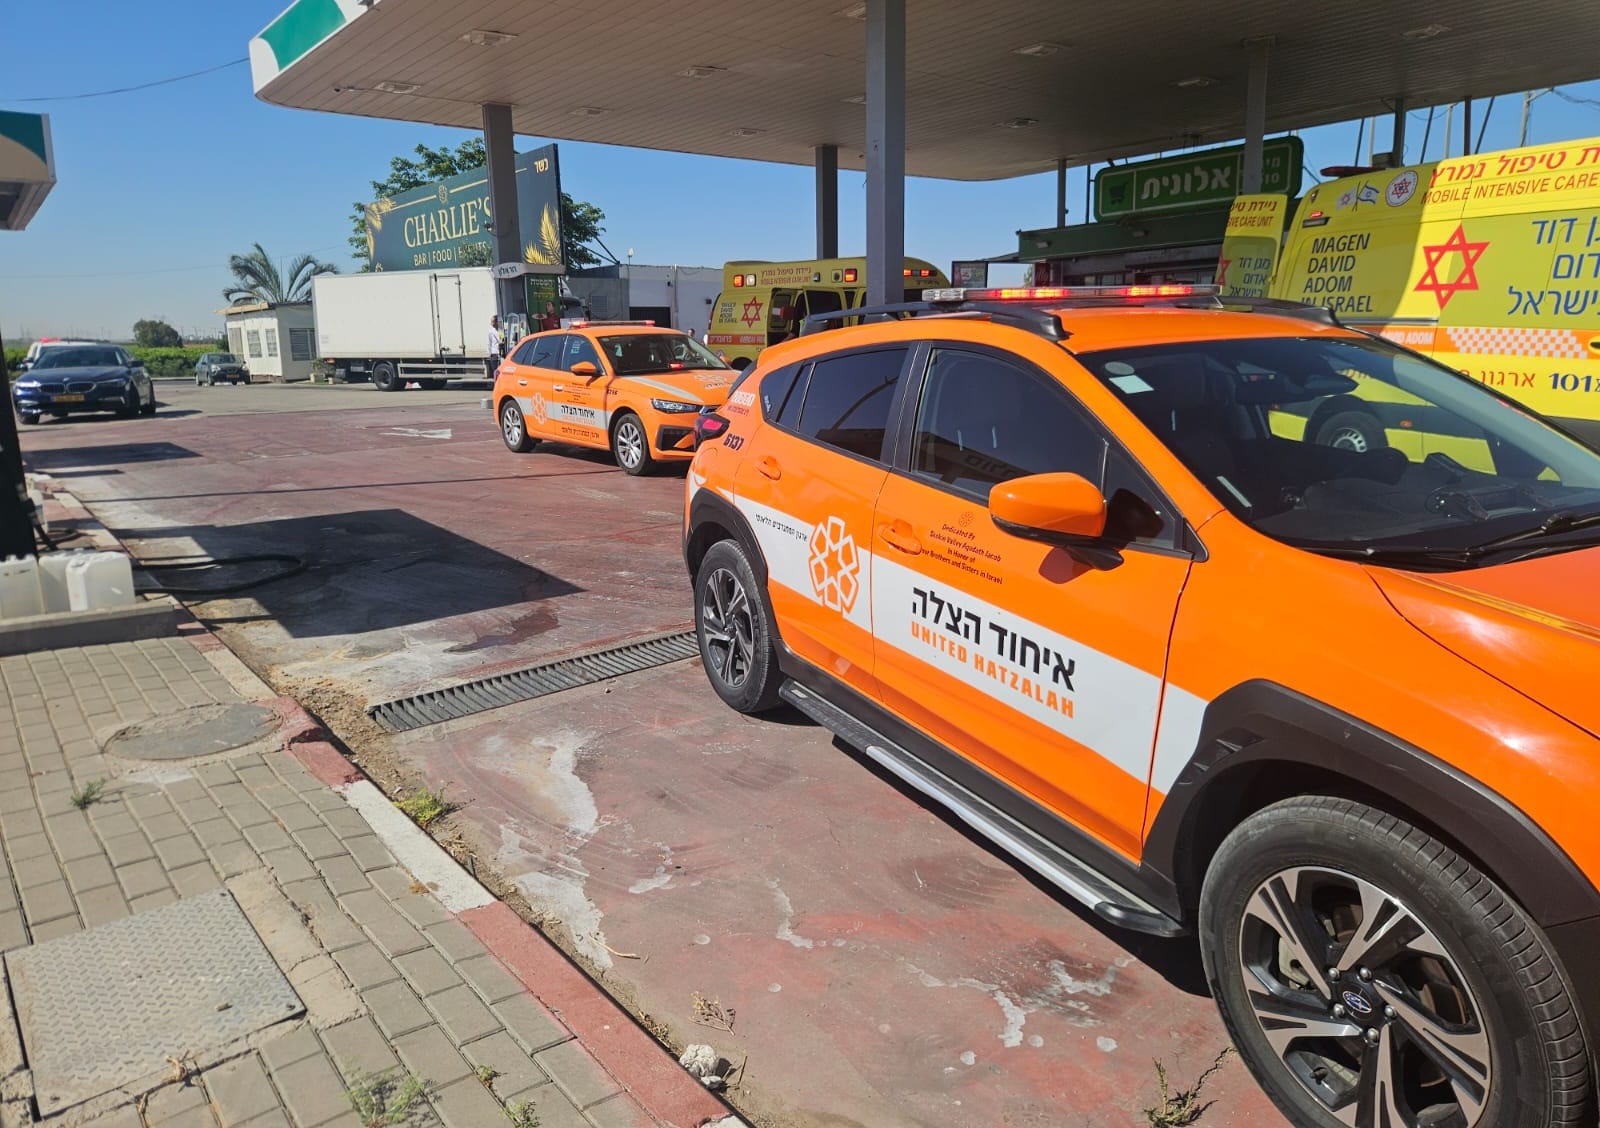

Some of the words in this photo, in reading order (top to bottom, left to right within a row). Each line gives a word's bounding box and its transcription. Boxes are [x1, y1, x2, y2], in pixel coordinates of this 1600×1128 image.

[1496, 150, 1567, 176] טיפול
[1140, 164, 1231, 200] אלונית
[1429, 162, 1486, 188] נמרץ
[1423, 187, 1470, 204] MOBILE
[1474, 178, 1550, 199] INTENSIVE
[1554, 171, 1600, 190] CARE
[1247, 200, 1278, 212] ניידת
[1532, 217, 1578, 245] דוד
[1311, 233, 1371, 254] MAGEN
[413, 253, 427, 267] BAR
[432, 248, 451, 263] FOOD
[1254, 257, 1271, 271] מגן
[1307, 255, 1356, 274] DAVID
[1243, 272, 1267, 285] אדום
[1303, 275, 1353, 293] ADOM
[1321, 295, 1373, 313] ISRAEL
[723, 433, 744, 451] 6137
[942, 523, 968, 538] Dedicated
[953, 551, 969, 561] Honor
[930, 550, 951, 564] Brothers
[951, 559, 961, 568] and
[961, 562, 979, 575] Sisters
[986, 572, 1003, 585] Israel
[912, 586, 981, 645] הצלה
[988, 621, 1075, 692] איחוד
[911, 620, 967, 664] UNITED
[974, 652, 1074, 719] HATZALAH
